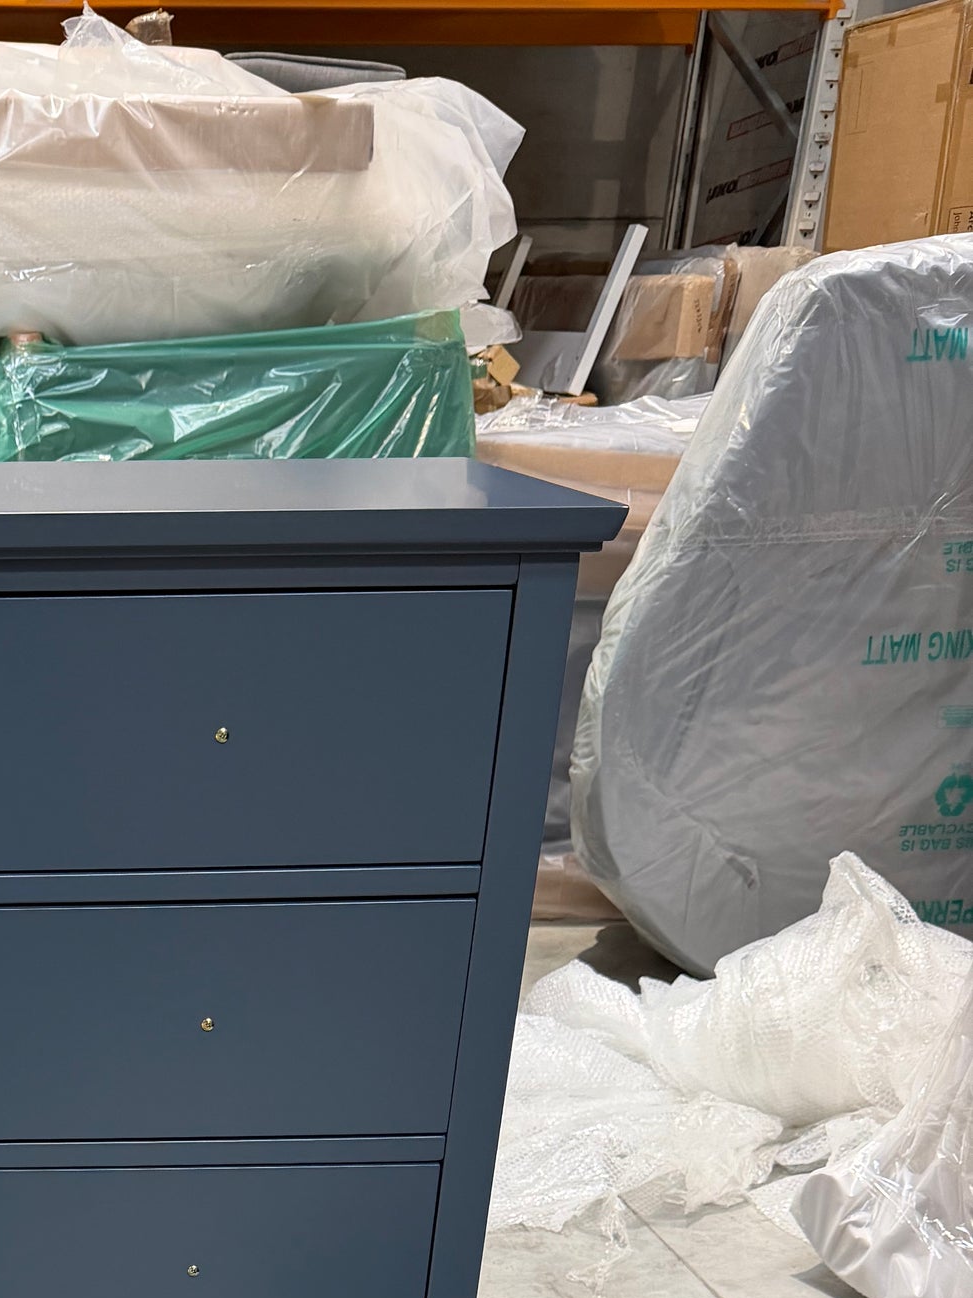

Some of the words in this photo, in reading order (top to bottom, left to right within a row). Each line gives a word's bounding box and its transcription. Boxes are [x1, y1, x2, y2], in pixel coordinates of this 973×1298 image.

[906, 327, 969, 362] MATT
[861, 632, 922, 665] MATT
[900, 839, 915, 852] IS
[920, 838, 952, 851] BAG
